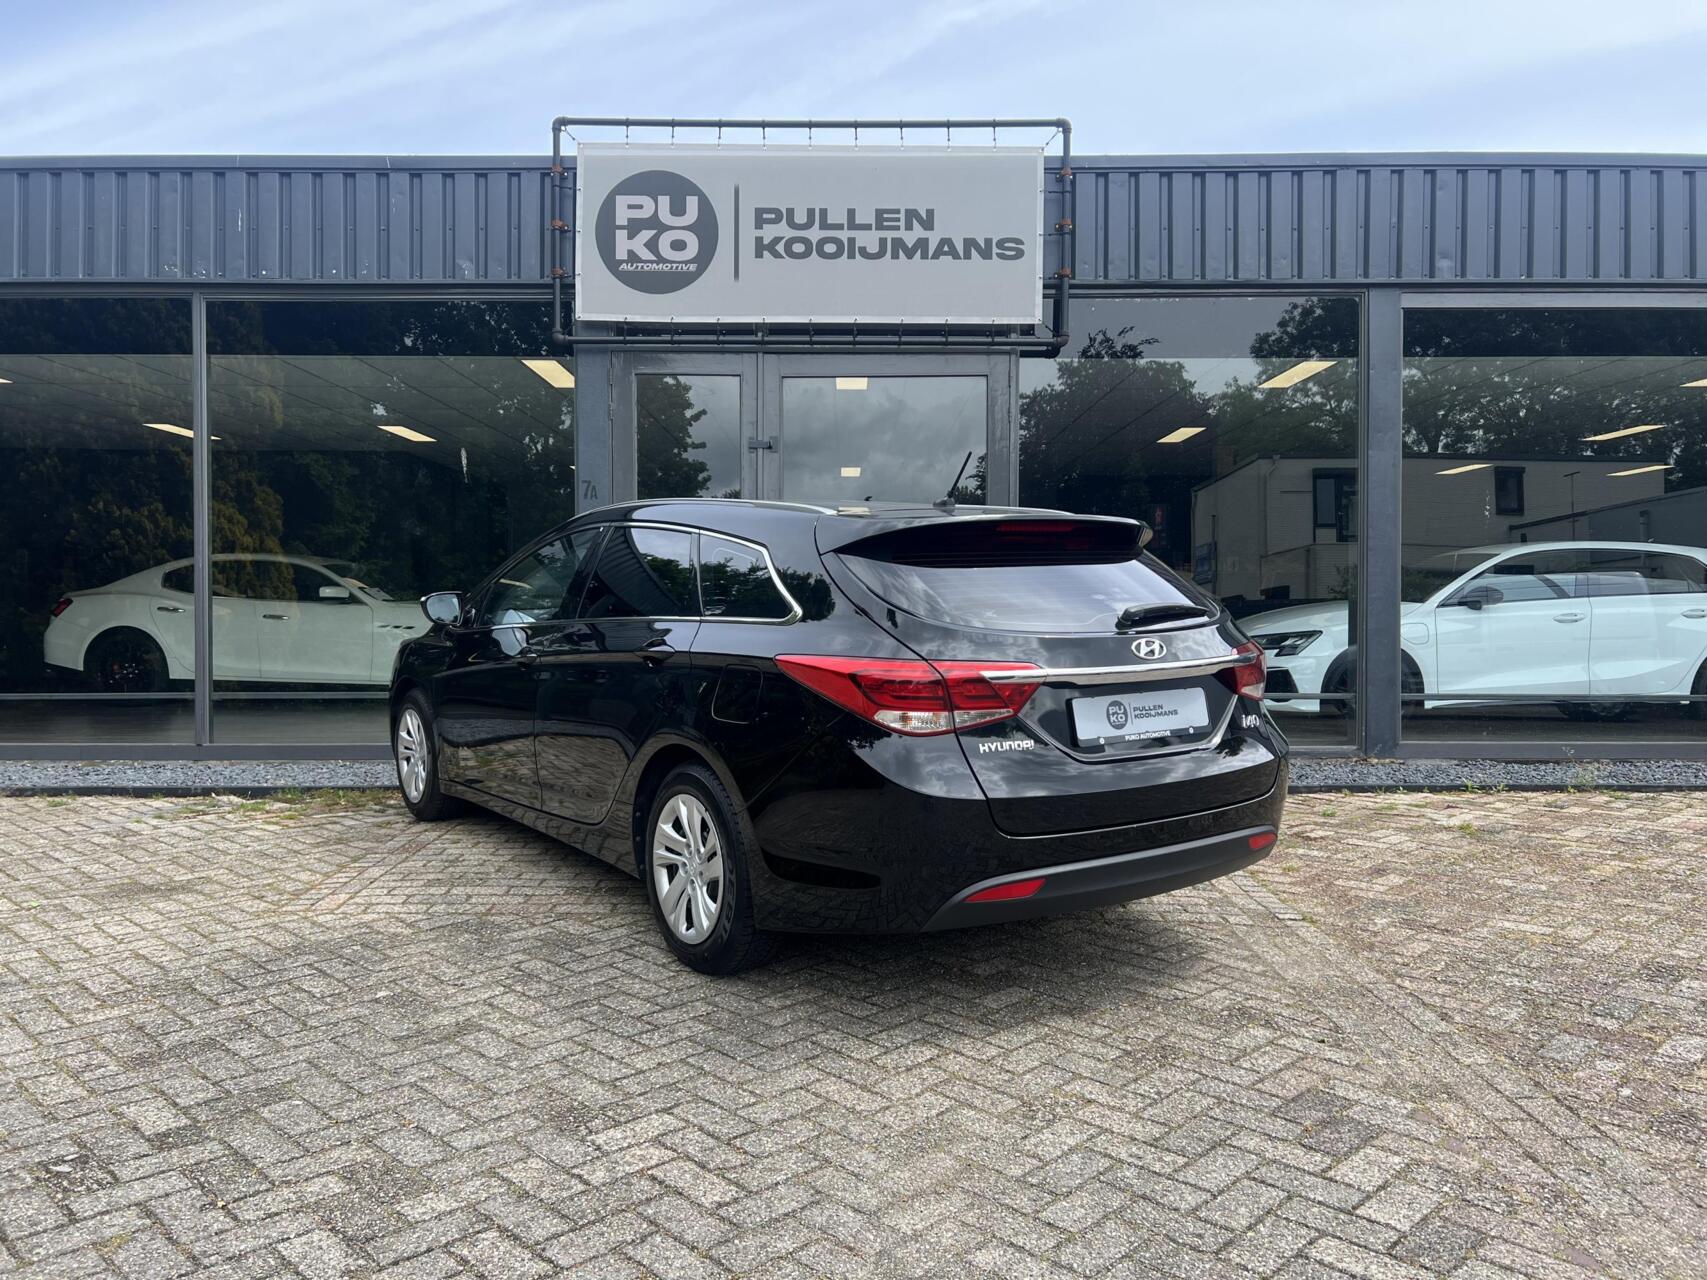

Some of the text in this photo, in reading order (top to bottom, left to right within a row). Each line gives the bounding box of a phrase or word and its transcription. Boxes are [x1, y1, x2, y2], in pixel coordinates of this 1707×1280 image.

[615, 195, 699, 227] PU
[754, 207, 935, 231] PULLEN
[615, 229, 699, 261] KO
[754, 236, 1025, 261] KOOIJMANS
[618, 262, 698, 272] AUTOMOTIVE
[581, 479, 599, 500] 7A
[1108, 705, 1124, 715] PU
[1133, 703, 1164, 713] PULLEN
[1134, 709, 1179, 720] KOOIJMANS
[1109, 713, 1126, 723] KO
[979, 739, 1035, 754] HYUNDAI
